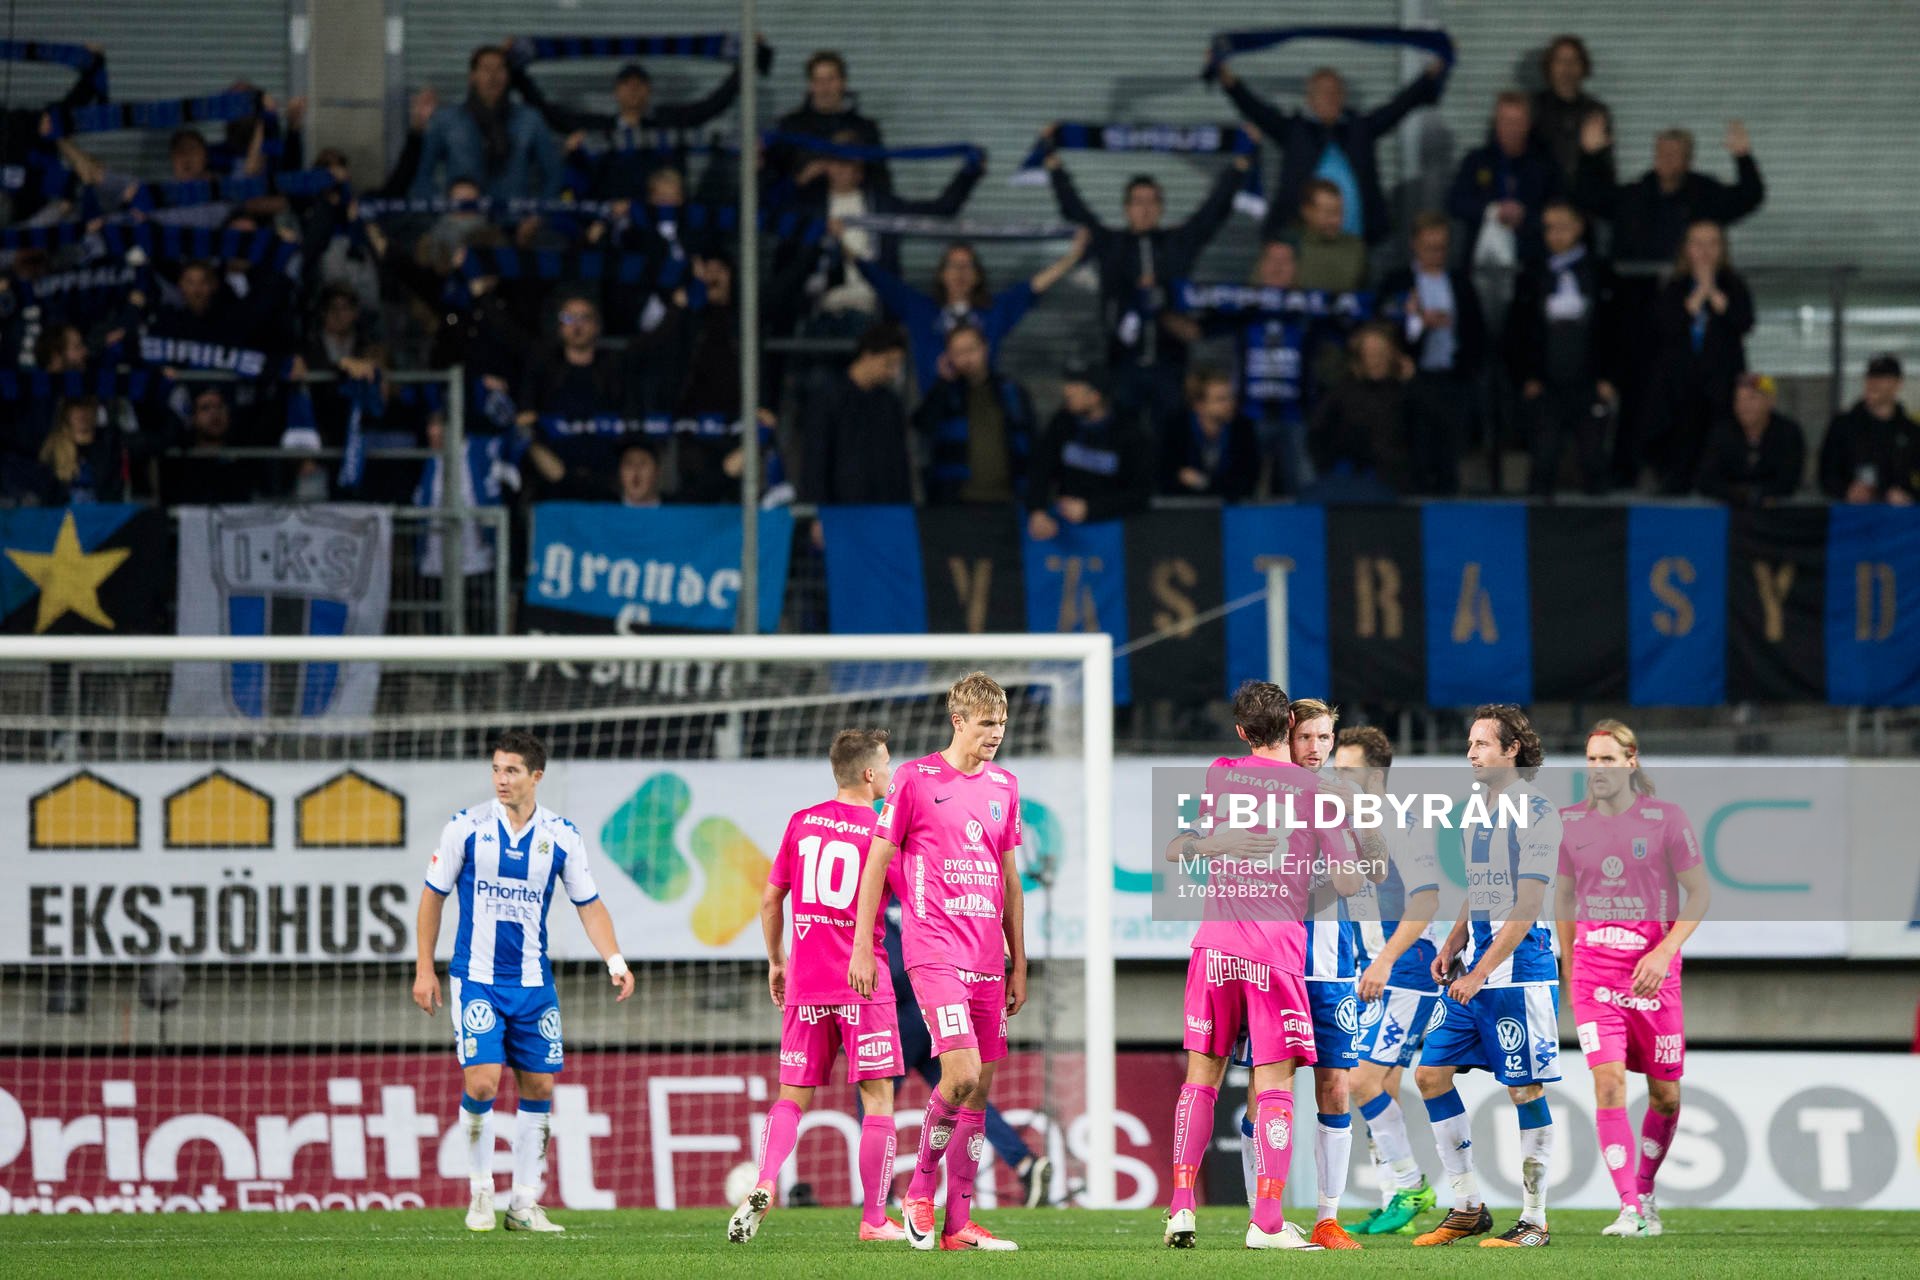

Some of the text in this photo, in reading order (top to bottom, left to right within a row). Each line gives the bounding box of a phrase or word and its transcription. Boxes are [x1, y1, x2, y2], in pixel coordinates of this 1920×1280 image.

[139, 335, 267, 377] SIRIUS
[1280, 782, 1304, 796] TAK
[803, 814, 871, 836] ÅRSTA TAK
[798, 835, 861, 910] 10
[944, 859, 973, 872] BYGG
[943, 872, 999, 887] CONSTRUCT
[477, 880, 542, 904] Prioritet
[28, 868, 409, 957] EKSJÖHUS
[1612, 991, 1661, 1011] Koneo
[1283, 1018, 1312, 1035] RELITA
[549, 1042, 563, 1058] 23
[858, 1041, 893, 1057] RELITA
[1505, 1055, 1523, 1071] 42
